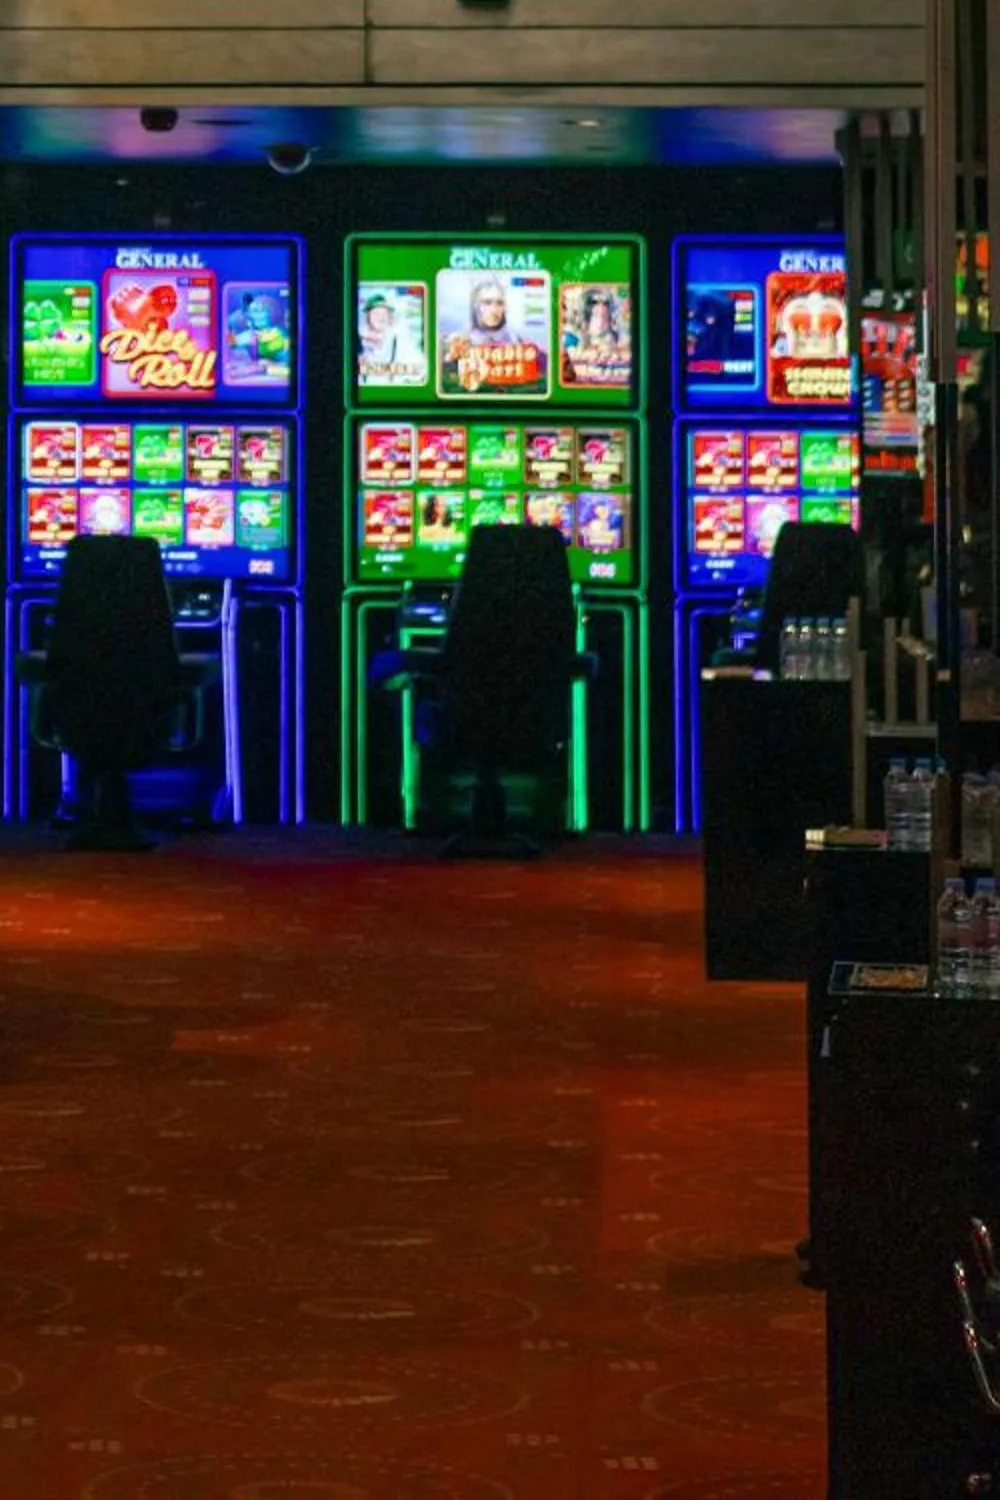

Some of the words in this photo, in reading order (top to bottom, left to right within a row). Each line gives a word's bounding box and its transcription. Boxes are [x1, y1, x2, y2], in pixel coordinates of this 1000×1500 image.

[116, 251, 204, 268] GENERAL
[449, 251, 541, 268] GENERAL
[129, 351, 217, 388] Roll
